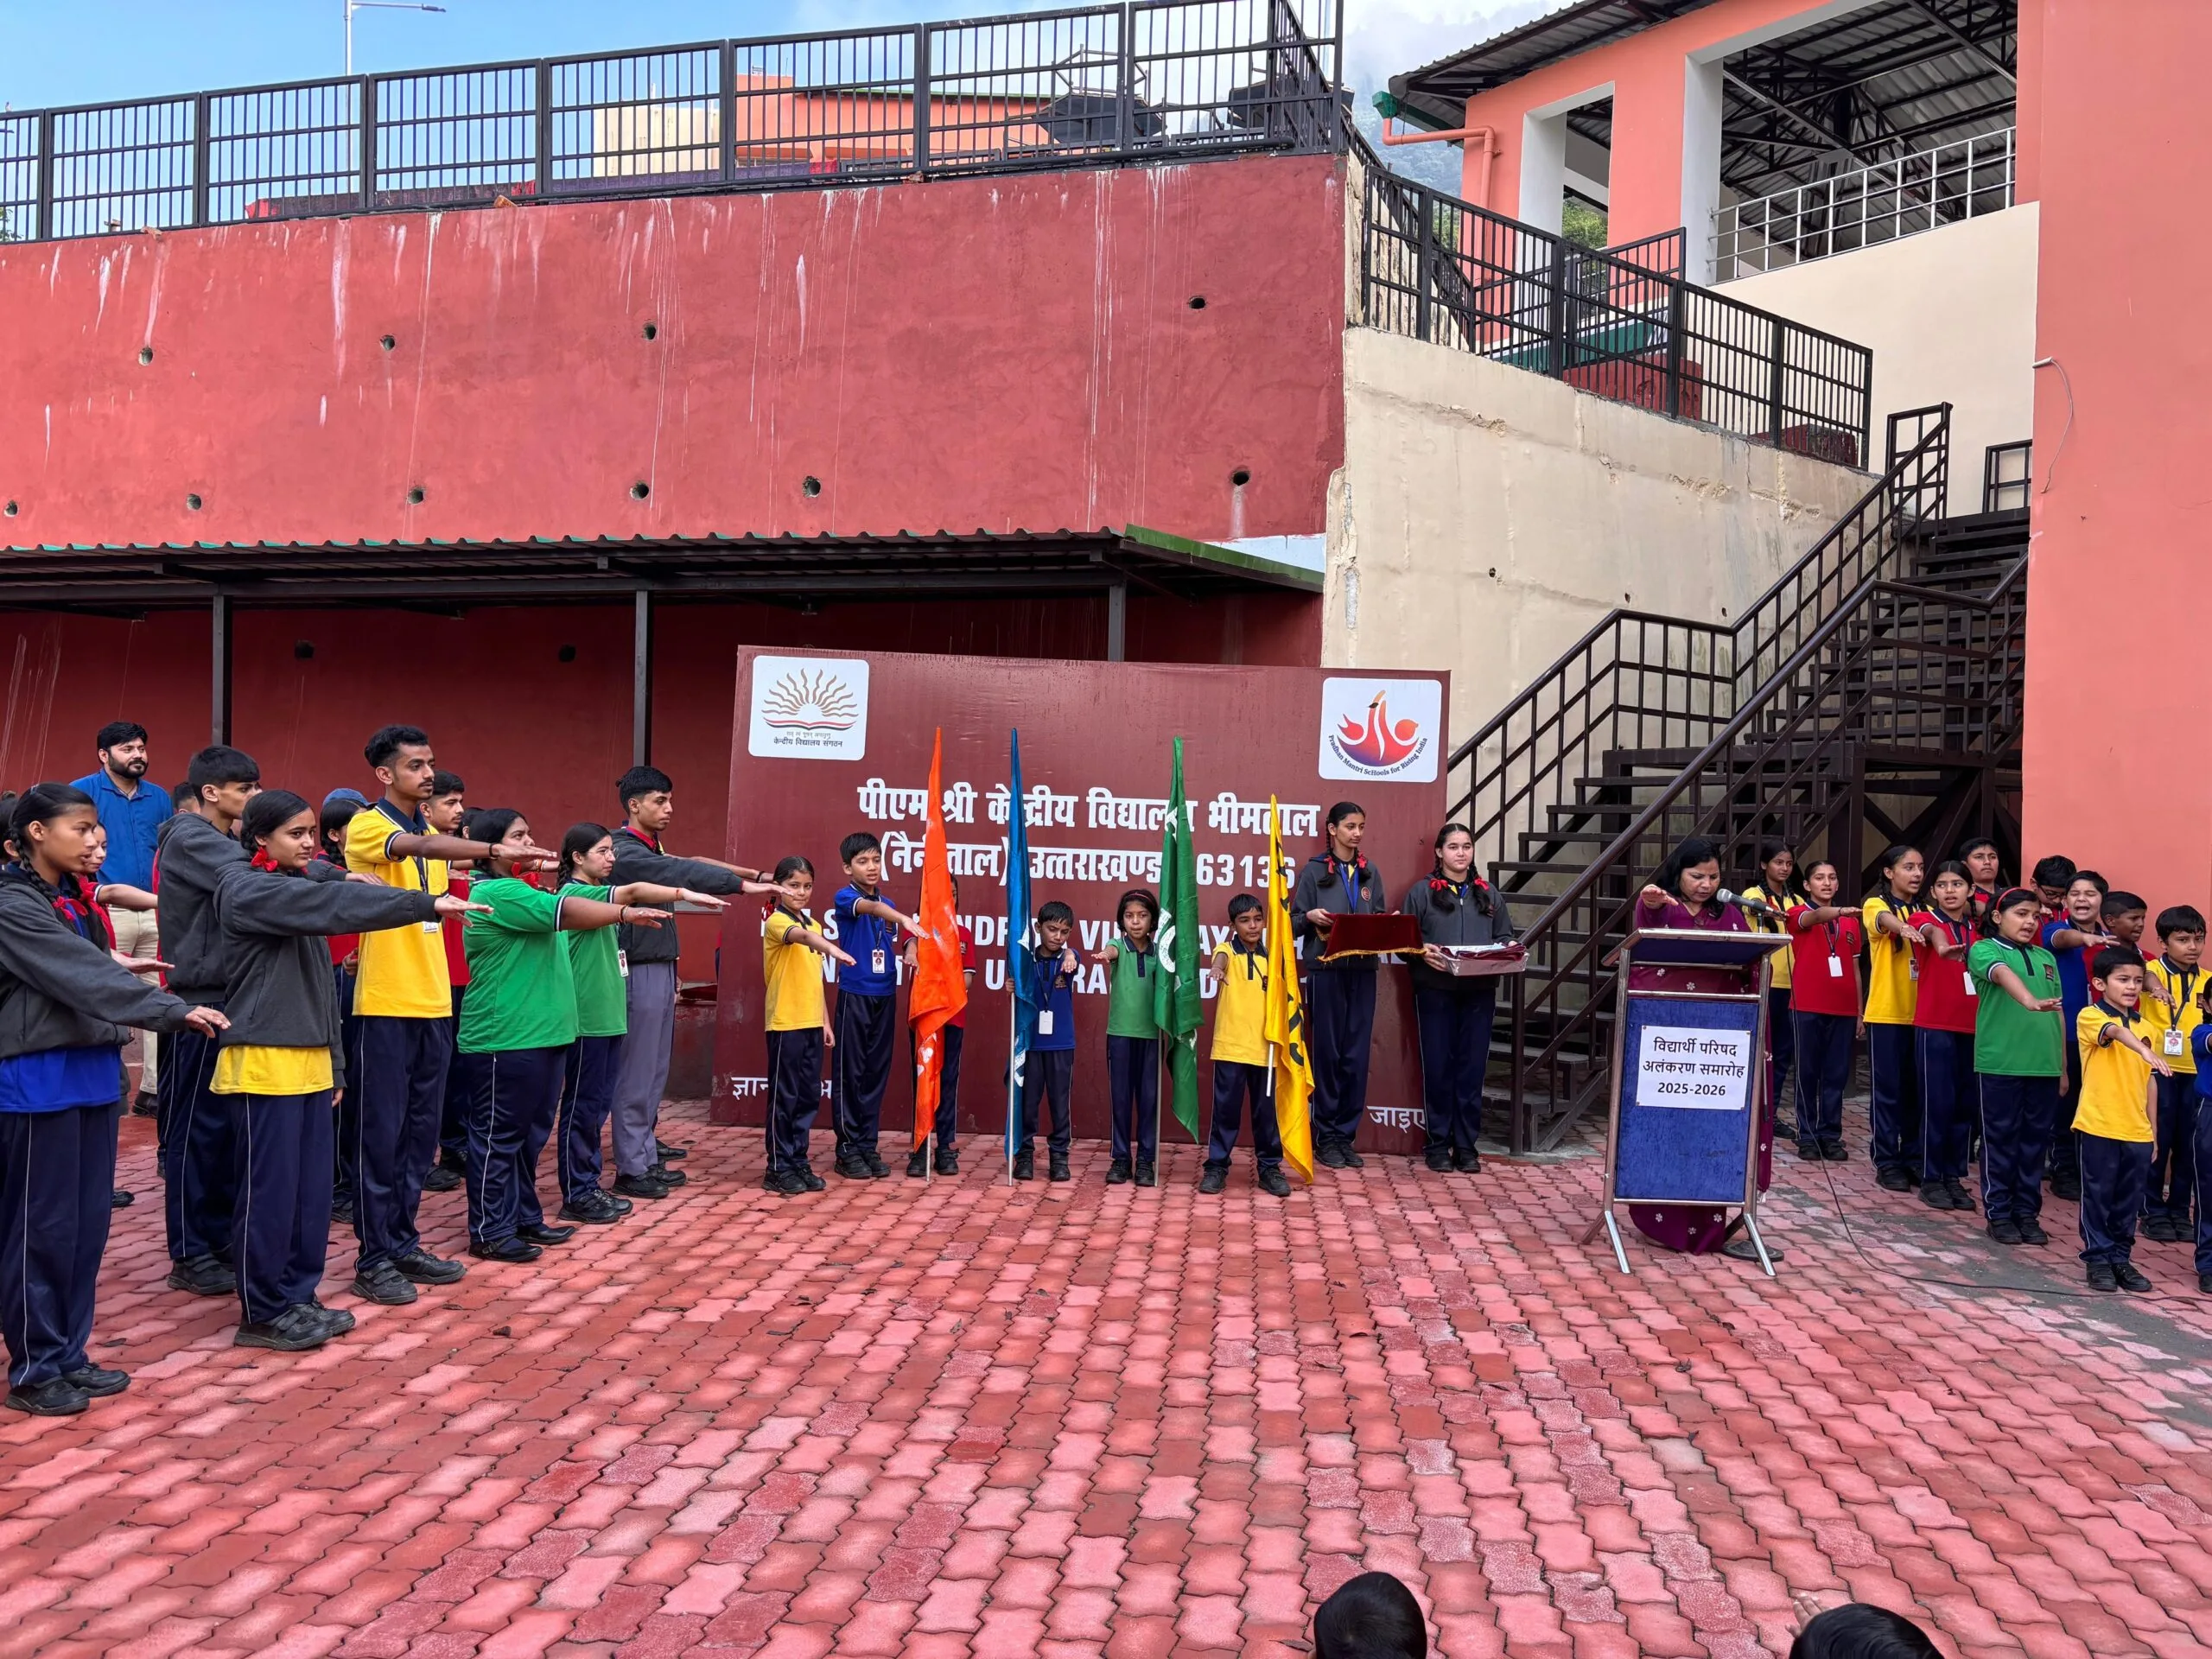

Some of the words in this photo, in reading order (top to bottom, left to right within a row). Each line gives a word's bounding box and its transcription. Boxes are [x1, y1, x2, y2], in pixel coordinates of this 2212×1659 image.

[1328, 734, 1344, 760] Pradhan
[1342, 758, 1363, 773] Mantri
[1390, 766, 1401, 774] for
[1400, 753, 1420, 770] Rising
[1415, 737, 1428, 754] India
[857, 778, 929, 822] पीएम
[941, 781, 978, 823] श्री
[1653, 1036, 1697, 1053] विद्यार्थी
[1700, 1039, 1738, 1058] परिषद
[1643, 1058, 1696, 1075] अलंकरण
[1700, 1061, 1745, 1078] समारोह
[1657, 1082, 1726, 1096] 2025-2026
